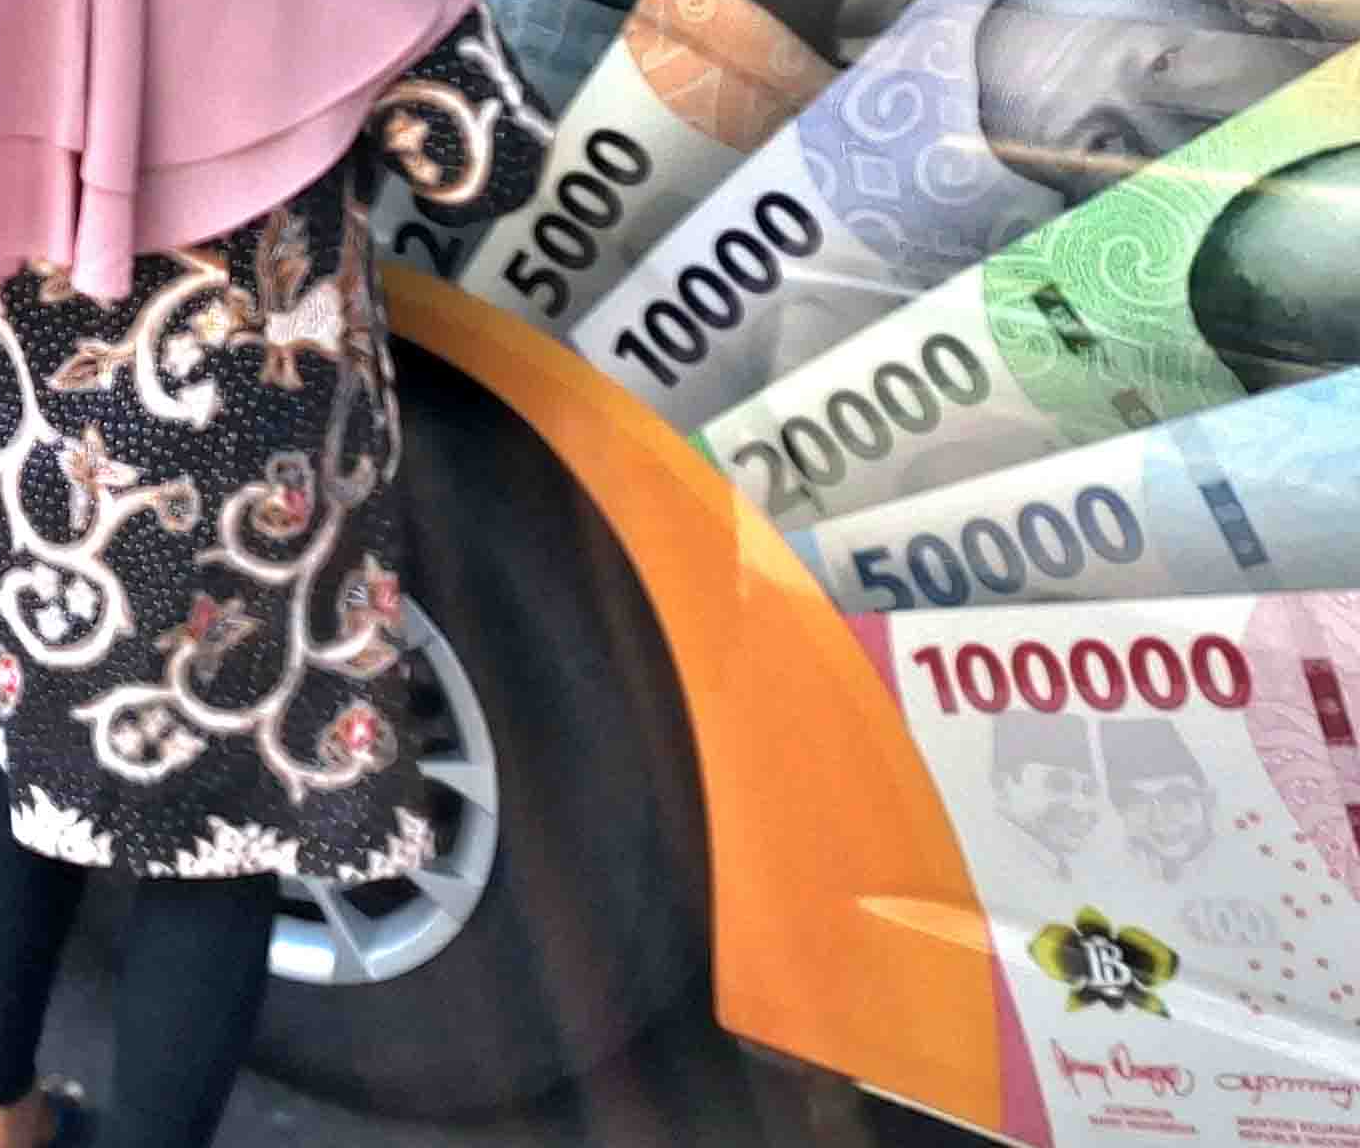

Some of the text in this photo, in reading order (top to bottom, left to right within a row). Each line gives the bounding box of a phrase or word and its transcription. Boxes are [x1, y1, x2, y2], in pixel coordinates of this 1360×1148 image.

[505, 128, 652, 318] 5000
[615, 190, 823, 388] 10000
[732, 332, 992, 513] 20000
[851, 484, 1145, 611] 50000
[913, 633, 1253, 715] 100000
